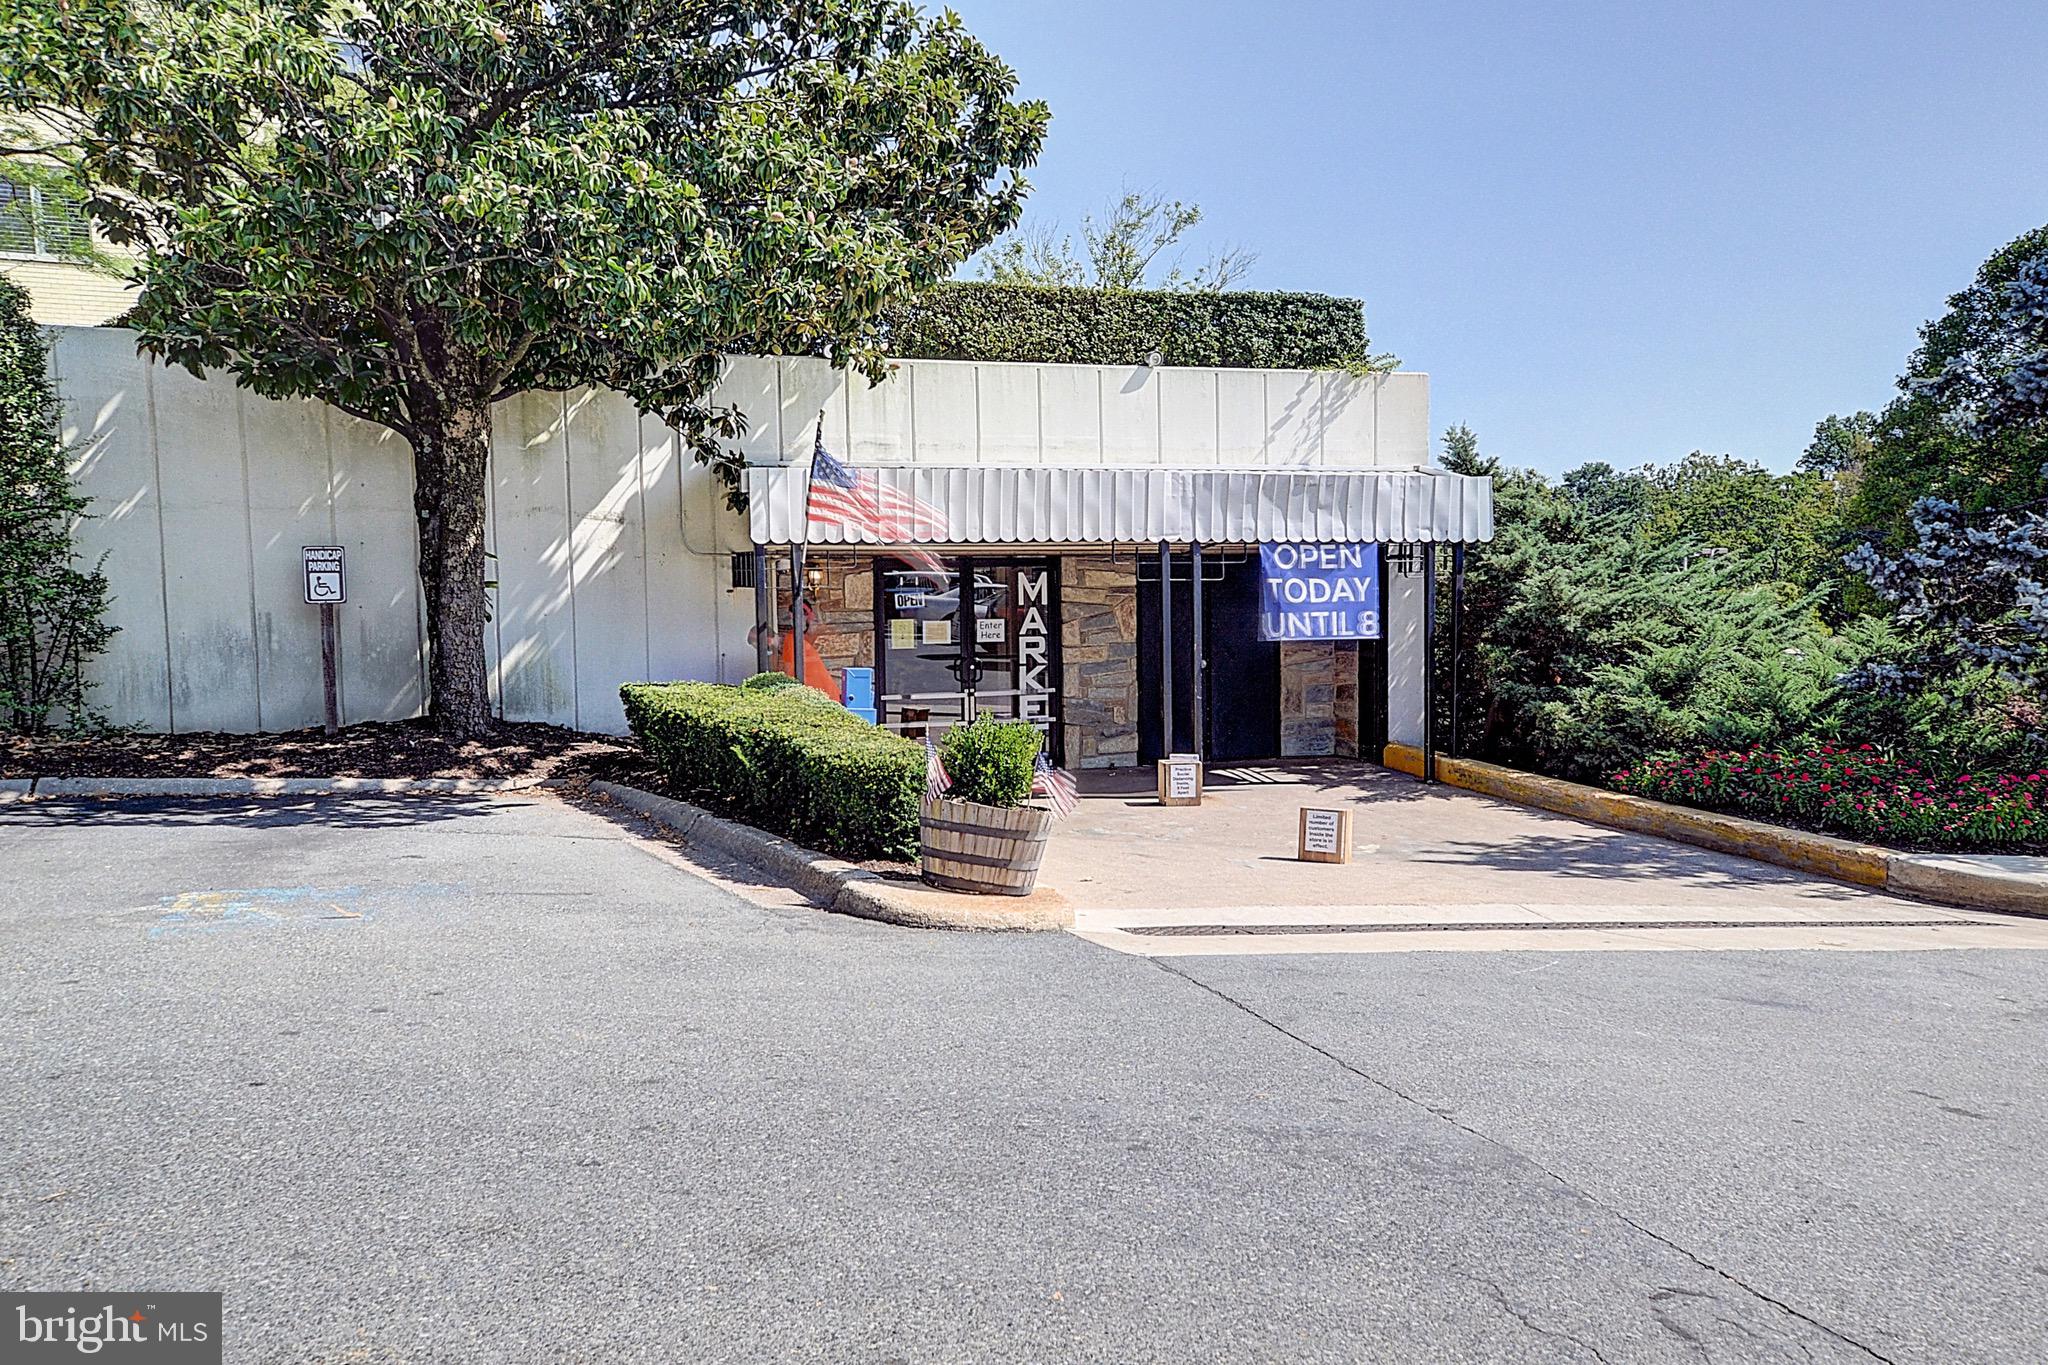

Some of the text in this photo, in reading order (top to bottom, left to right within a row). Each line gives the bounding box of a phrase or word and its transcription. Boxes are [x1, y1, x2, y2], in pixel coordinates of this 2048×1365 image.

[305, 550, 341, 560] HANDICAP
[1274, 544, 1362, 570] OPEN
[308, 561, 340, 571] PARKING
[1267, 577, 1371, 603] TODAY
[896, 594, 923, 607] OPEN
[979, 622, 1002, 630] Enter
[1263, 611, 1380, 638] UNTIL 8
